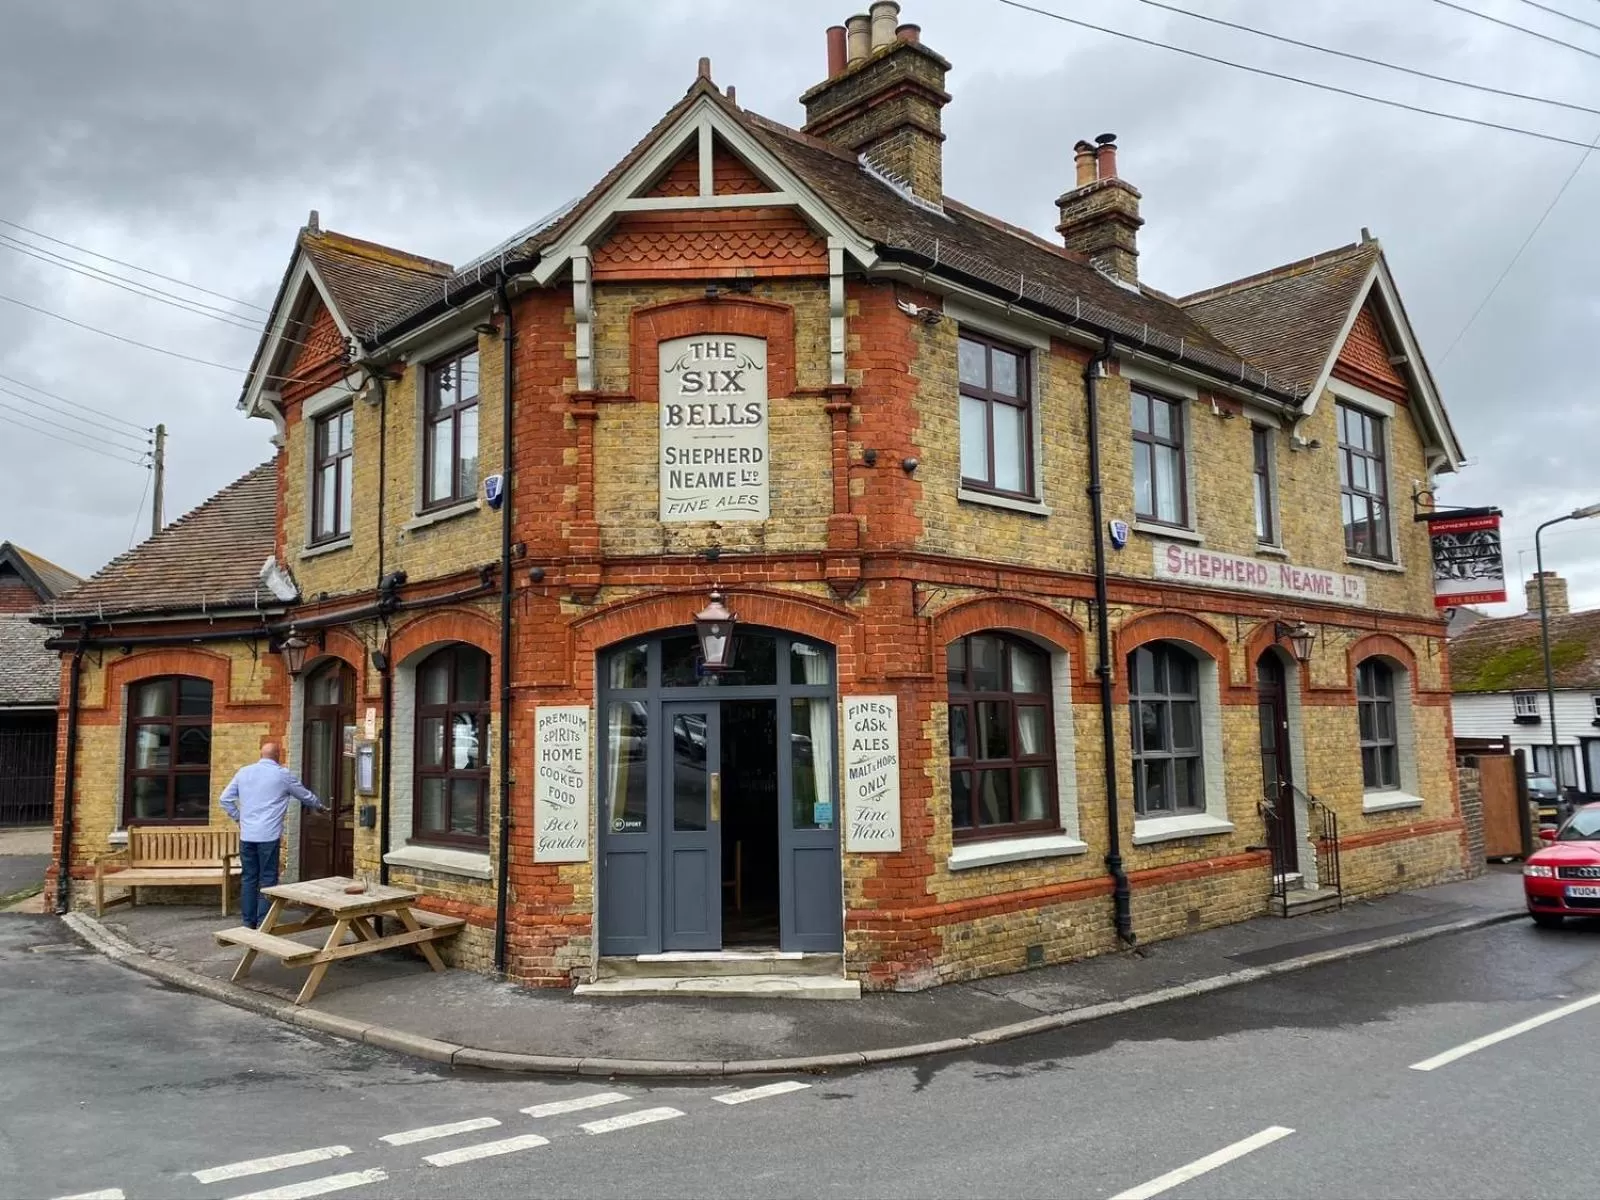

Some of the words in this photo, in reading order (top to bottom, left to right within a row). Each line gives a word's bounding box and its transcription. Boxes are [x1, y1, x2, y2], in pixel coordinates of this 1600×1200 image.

[690, 342, 736, 359] THE
[681, 370, 746, 393] SIX
[665, 402, 762, 426] BELLS
[665, 446, 763, 465] SHEPHERD
[670, 470, 736, 489] NEAME
[668, 499, 710, 514] FINE
[715, 495, 759, 508] ALES
[1166, 544, 1268, 585] SHEPHERD
[1280, 565, 1334, 595] NEAME
[849, 703, 893, 720] FINEST
[539, 713, 587, 732] PREMIUM
[854, 718, 887, 732] CASK
[543, 727, 580, 743] SPIRITS
[852, 738, 890, 751] ALES
[542, 748, 582, 761] HOME
[540, 766, 583, 789] COOKED
[859, 774, 887, 797] ONLY
[548, 786, 576, 805] FOOD
[855, 806, 889, 821] Fine
[544, 817, 578, 831] Beer
[852, 822, 895, 840] Wines
[539, 834, 586, 852] Garden
